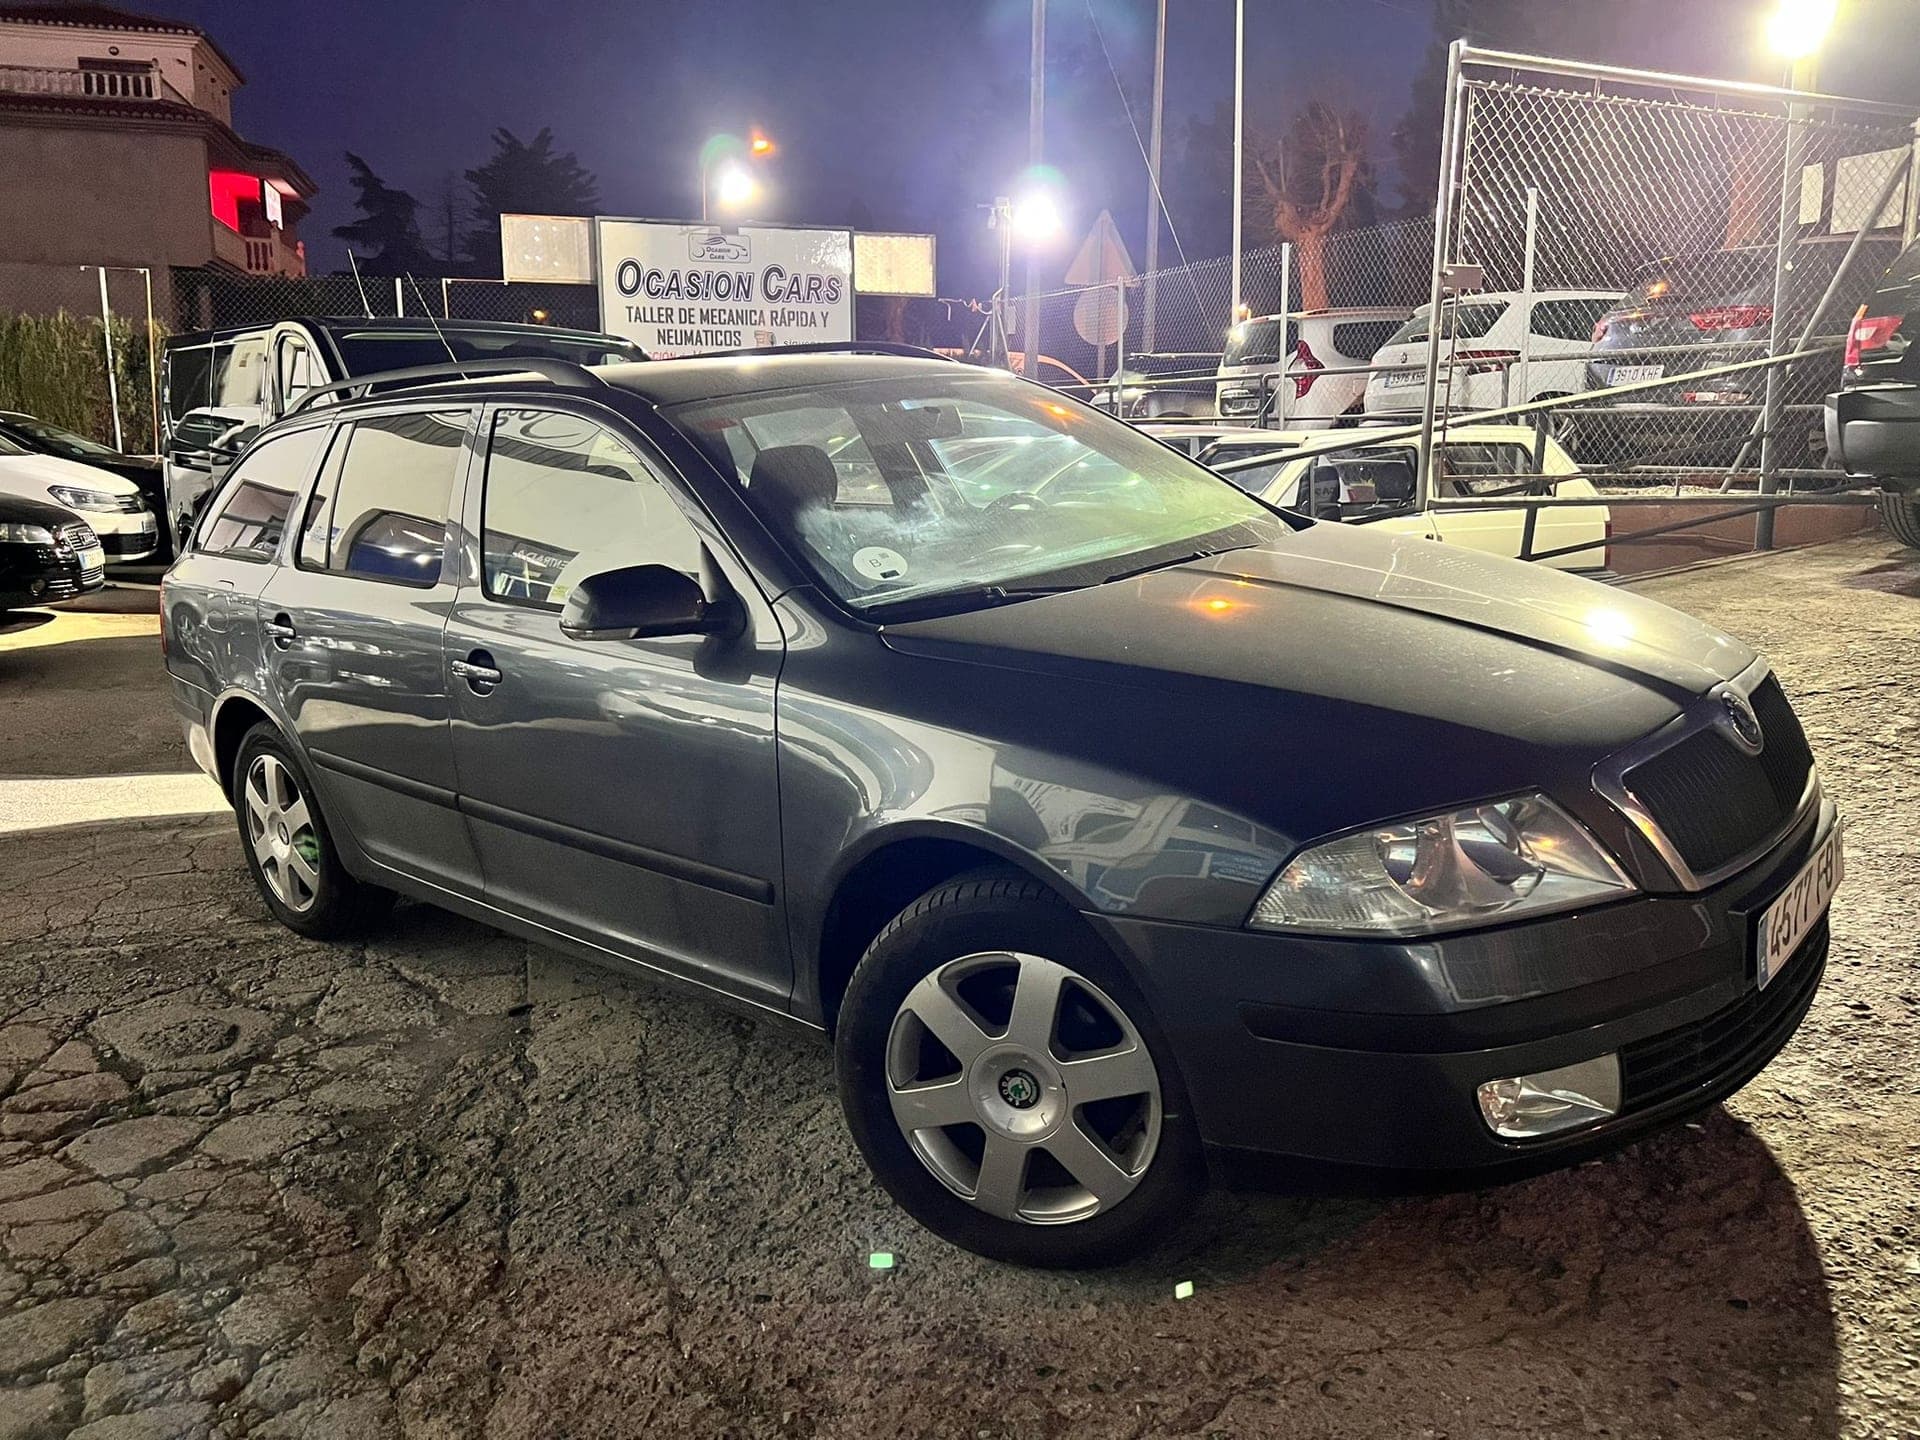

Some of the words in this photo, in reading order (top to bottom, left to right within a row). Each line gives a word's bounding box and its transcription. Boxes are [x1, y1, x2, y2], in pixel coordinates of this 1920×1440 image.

[615, 257, 754, 301] OCASION
[761, 263, 843, 304] CARS
[625, 306, 674, 324] TALLER
[678, 308, 695, 325] DE
[700, 308, 766, 327] MECANICA
[769, 308, 817, 328] RÁPIDA
[820, 311, 830, 328] Y
[656, 328, 742, 347] NEUMATICOS
[1770, 865, 1814, 957] 4577
